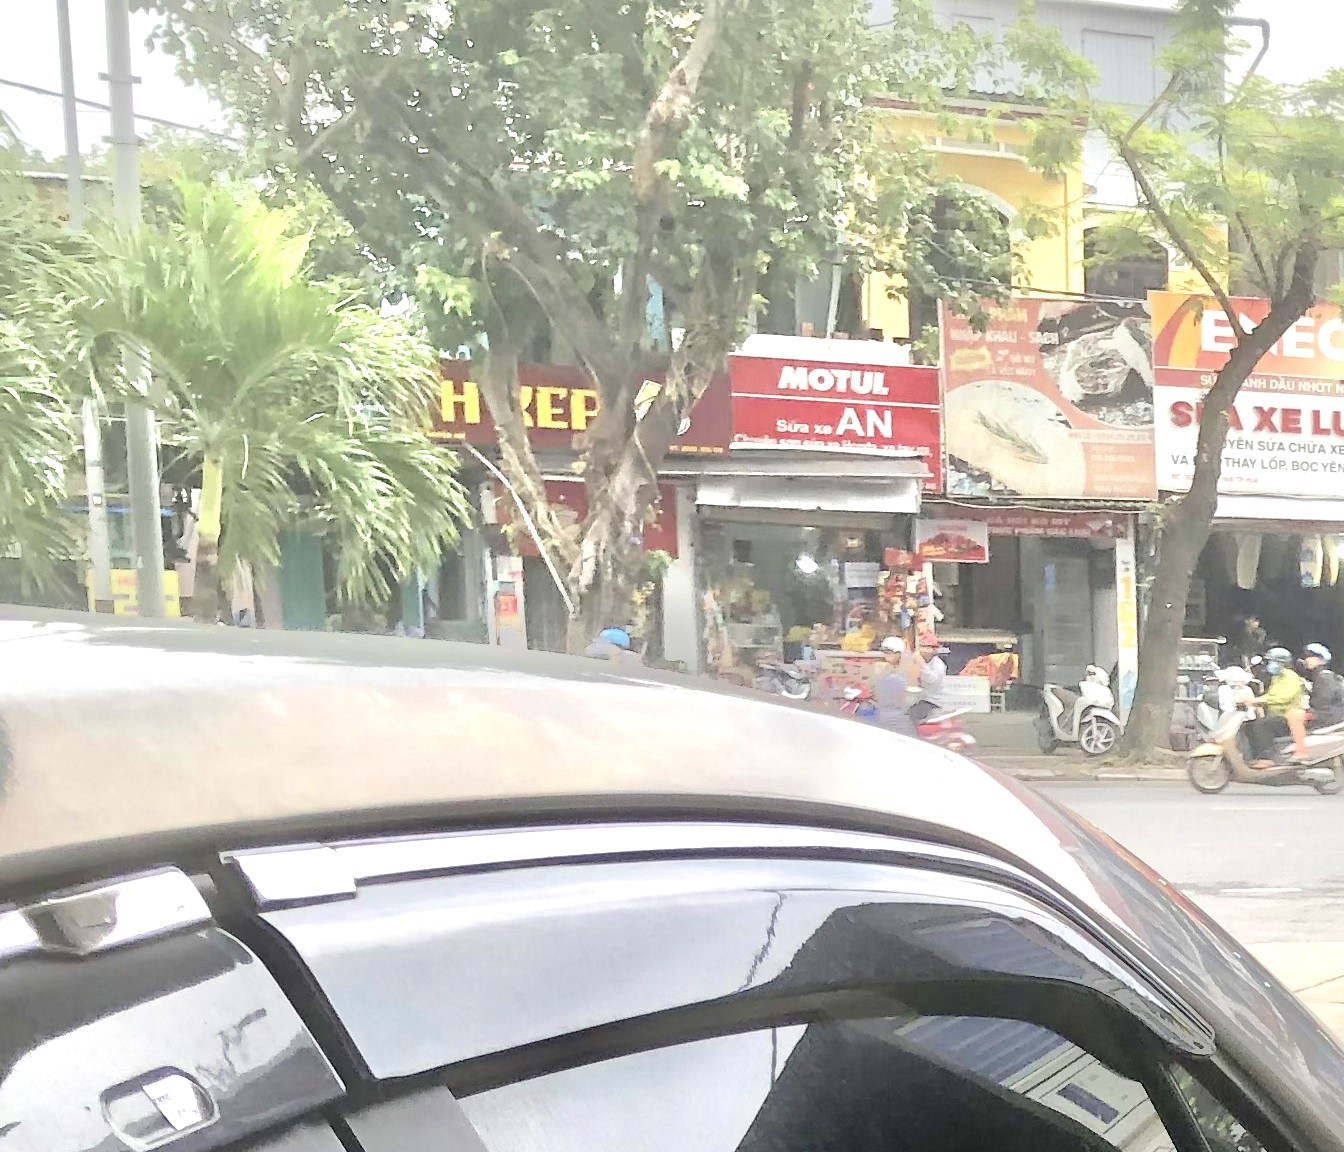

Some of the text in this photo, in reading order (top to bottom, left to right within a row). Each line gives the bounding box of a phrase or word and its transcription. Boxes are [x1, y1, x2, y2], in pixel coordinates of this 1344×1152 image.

[777, 365, 890, 396] MOTUL
[813, 424, 832, 435] xe
[835, 407, 893, 438] AN
[1170, 400, 1244, 431] SA
[1253, 405, 1302, 434] XE
[1224, 457, 1257, 469] THAY
